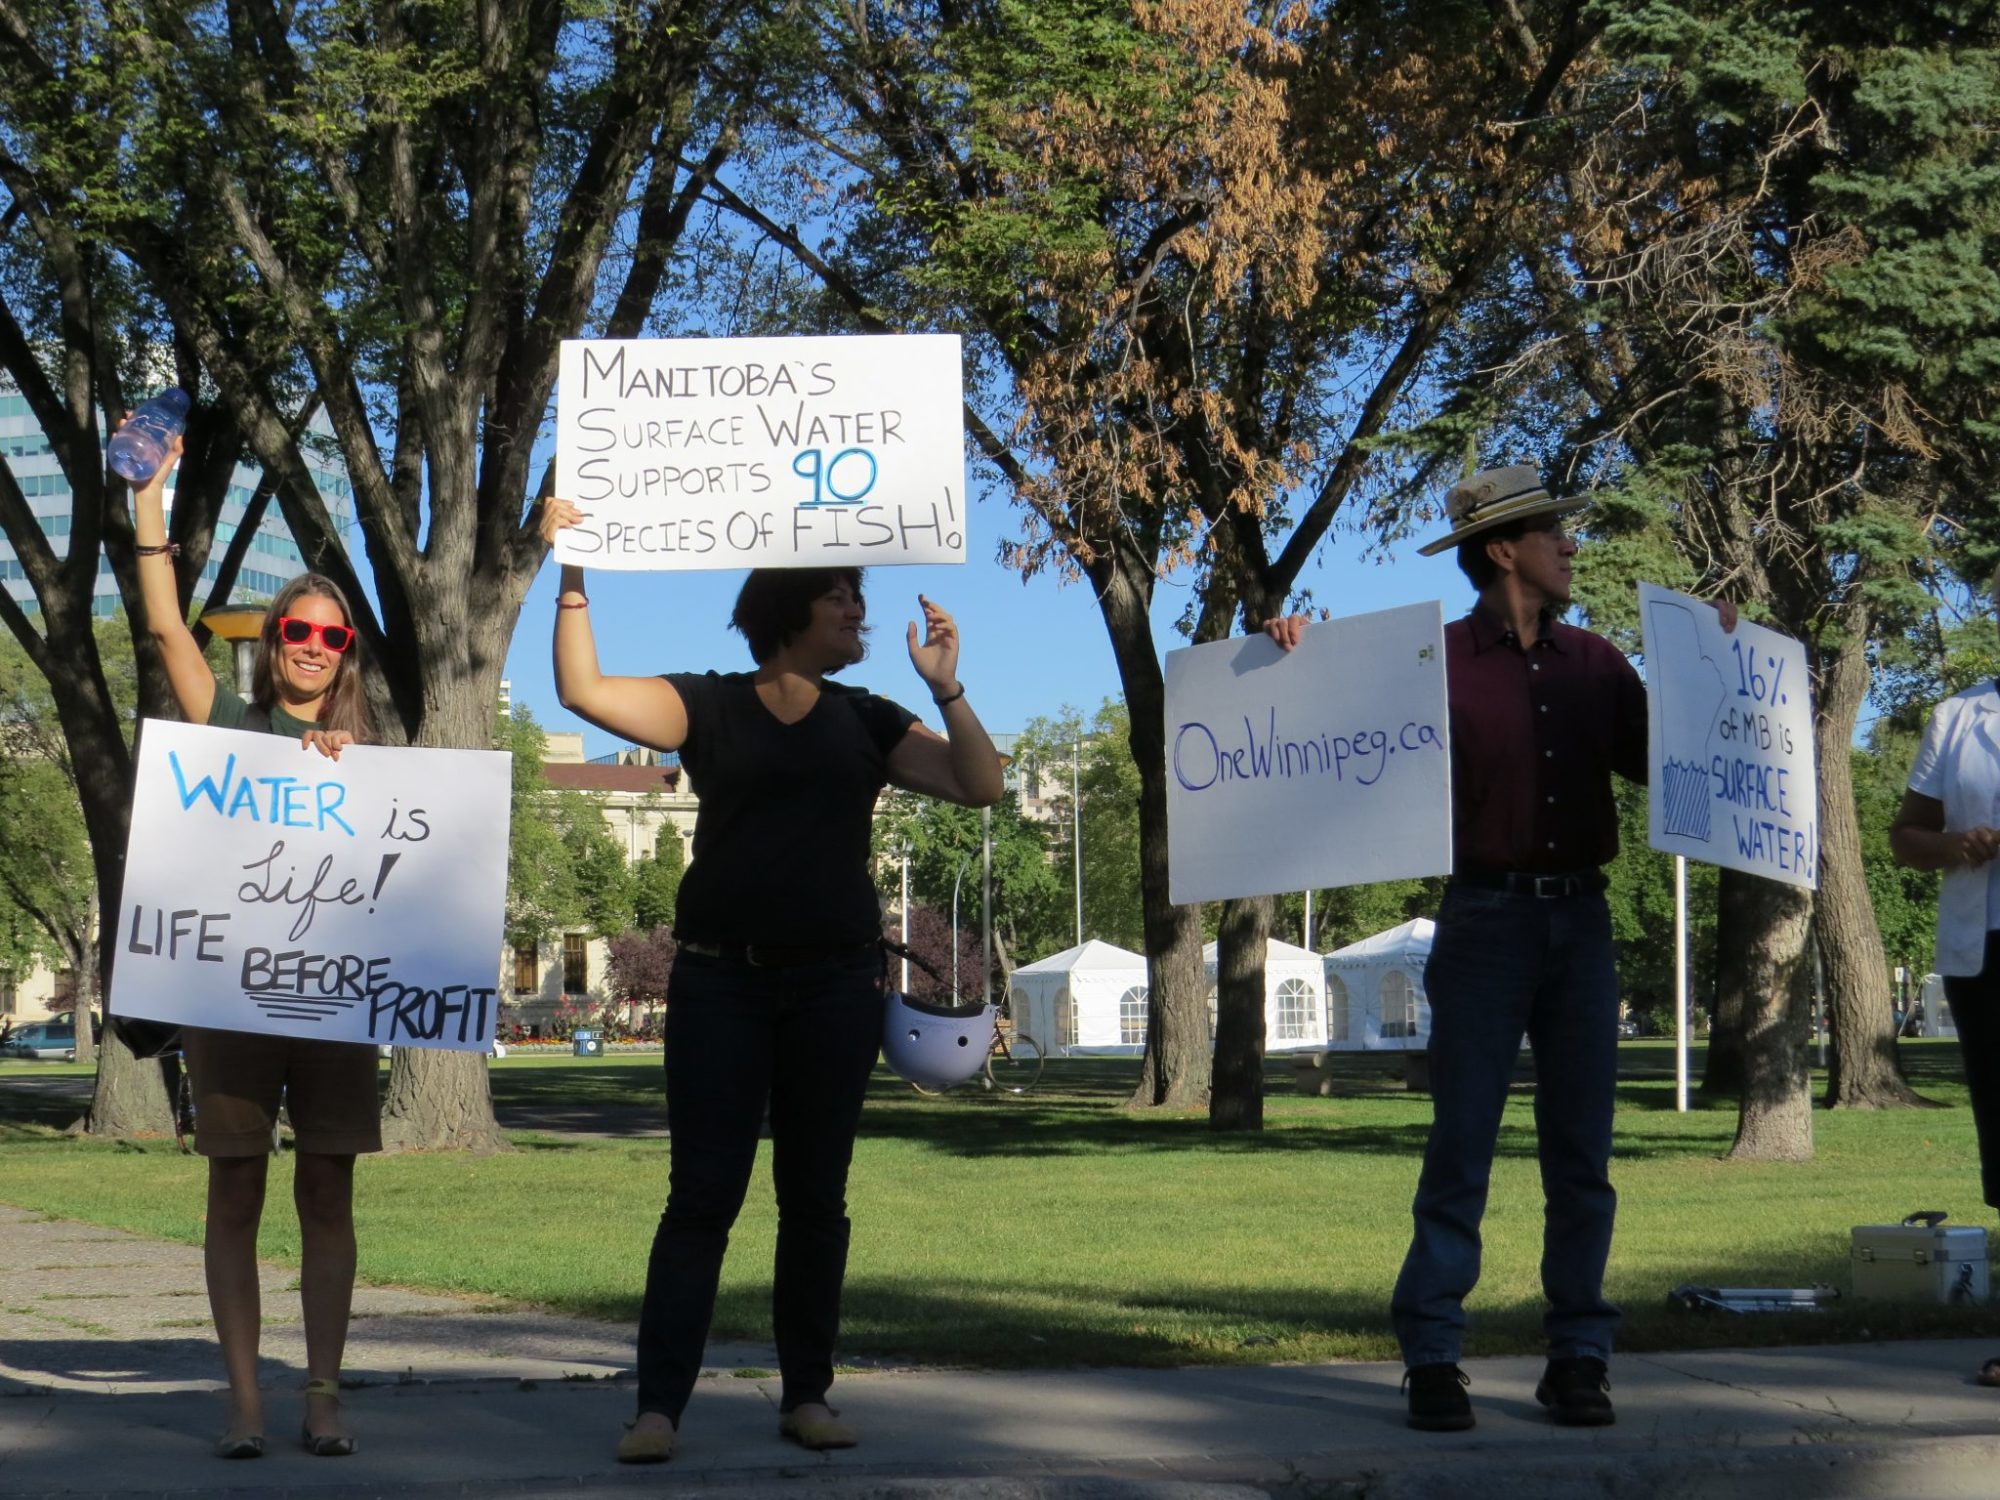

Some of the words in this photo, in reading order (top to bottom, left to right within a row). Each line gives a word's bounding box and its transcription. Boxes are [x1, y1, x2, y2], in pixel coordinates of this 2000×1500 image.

[577, 408, 744, 452] SURFACE
[757, 401, 905, 447] WATER
[577, 459, 771, 500] SUPPORTS
[793, 448, 878, 502] 90
[566, 513, 716, 554] SPECIES
[793, 486, 962, 552] FISH!
[1732, 639, 1787, 707] 16%
[1173, 706, 1444, 791] OneWinnipeg.ca
[1743, 712, 1771, 750] MB
[1778, 723, 1793, 755] is
[169, 750, 355, 836] WATER
[381, 798, 431, 841] is
[1711, 755, 1791, 818] SURFACE
[1733, 814, 1813, 878] WATER!
[238, 840, 401, 942] Life!
[128, 905, 231, 962] LIFE
[241, 947, 391, 997] BEFORE
[368, 981, 496, 1042] PROFIT
